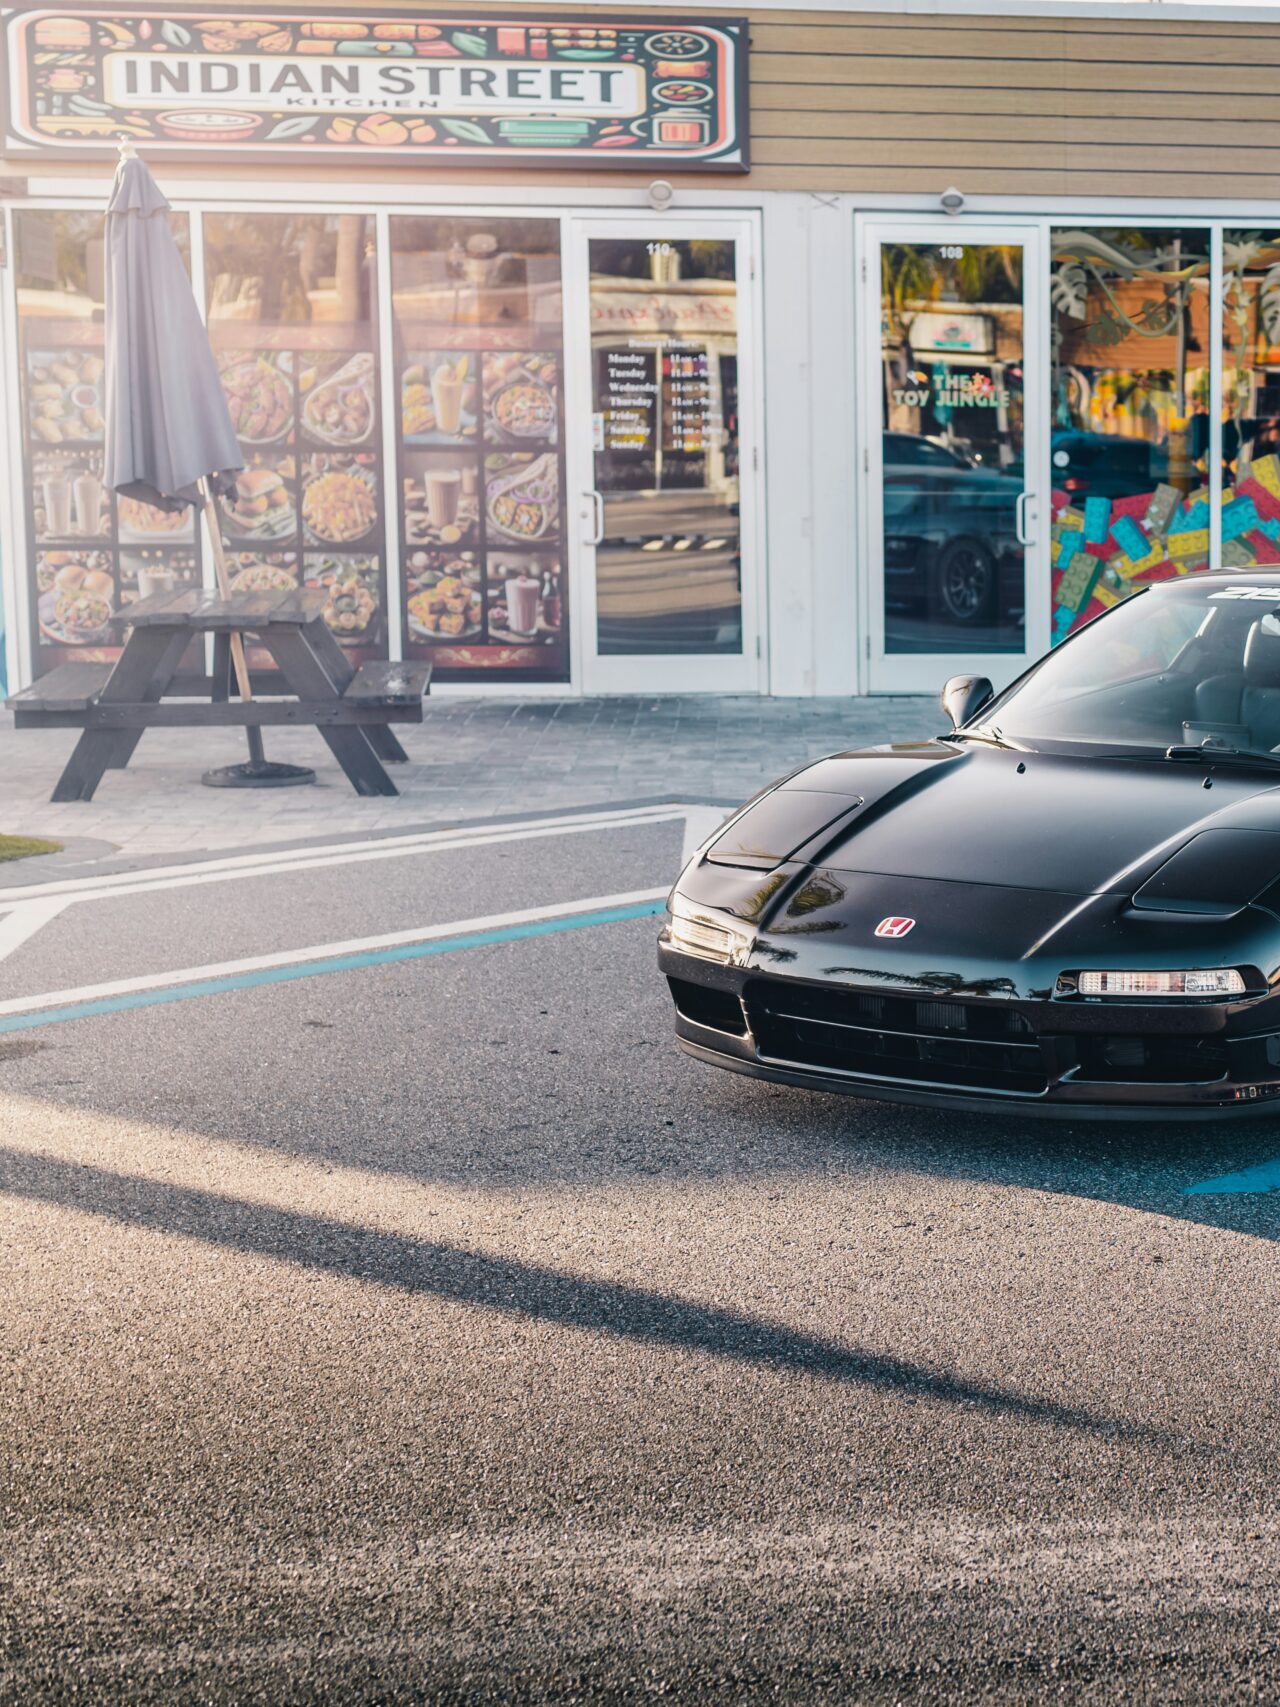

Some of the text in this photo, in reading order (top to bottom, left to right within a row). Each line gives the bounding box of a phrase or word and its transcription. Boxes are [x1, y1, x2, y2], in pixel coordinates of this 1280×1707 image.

[124, 59, 625, 103] INDIAN STREET
[286, 97, 439, 109] KITCHEN
[645, 242, 671, 257] 110
[607, 353, 645, 365] Monday
[608, 367, 646, 380] Tuesday
[608, 382, 660, 394] Wednesday
[932, 374, 970, 390] THE
[609, 396, 654, 408] Thursday
[893, 390, 1010, 408] TOY JUNGLE
[609, 411, 640, 423] Friday
[610, 425, 651, 437] Saturday
[610, 439, 645, 451] Sunday
